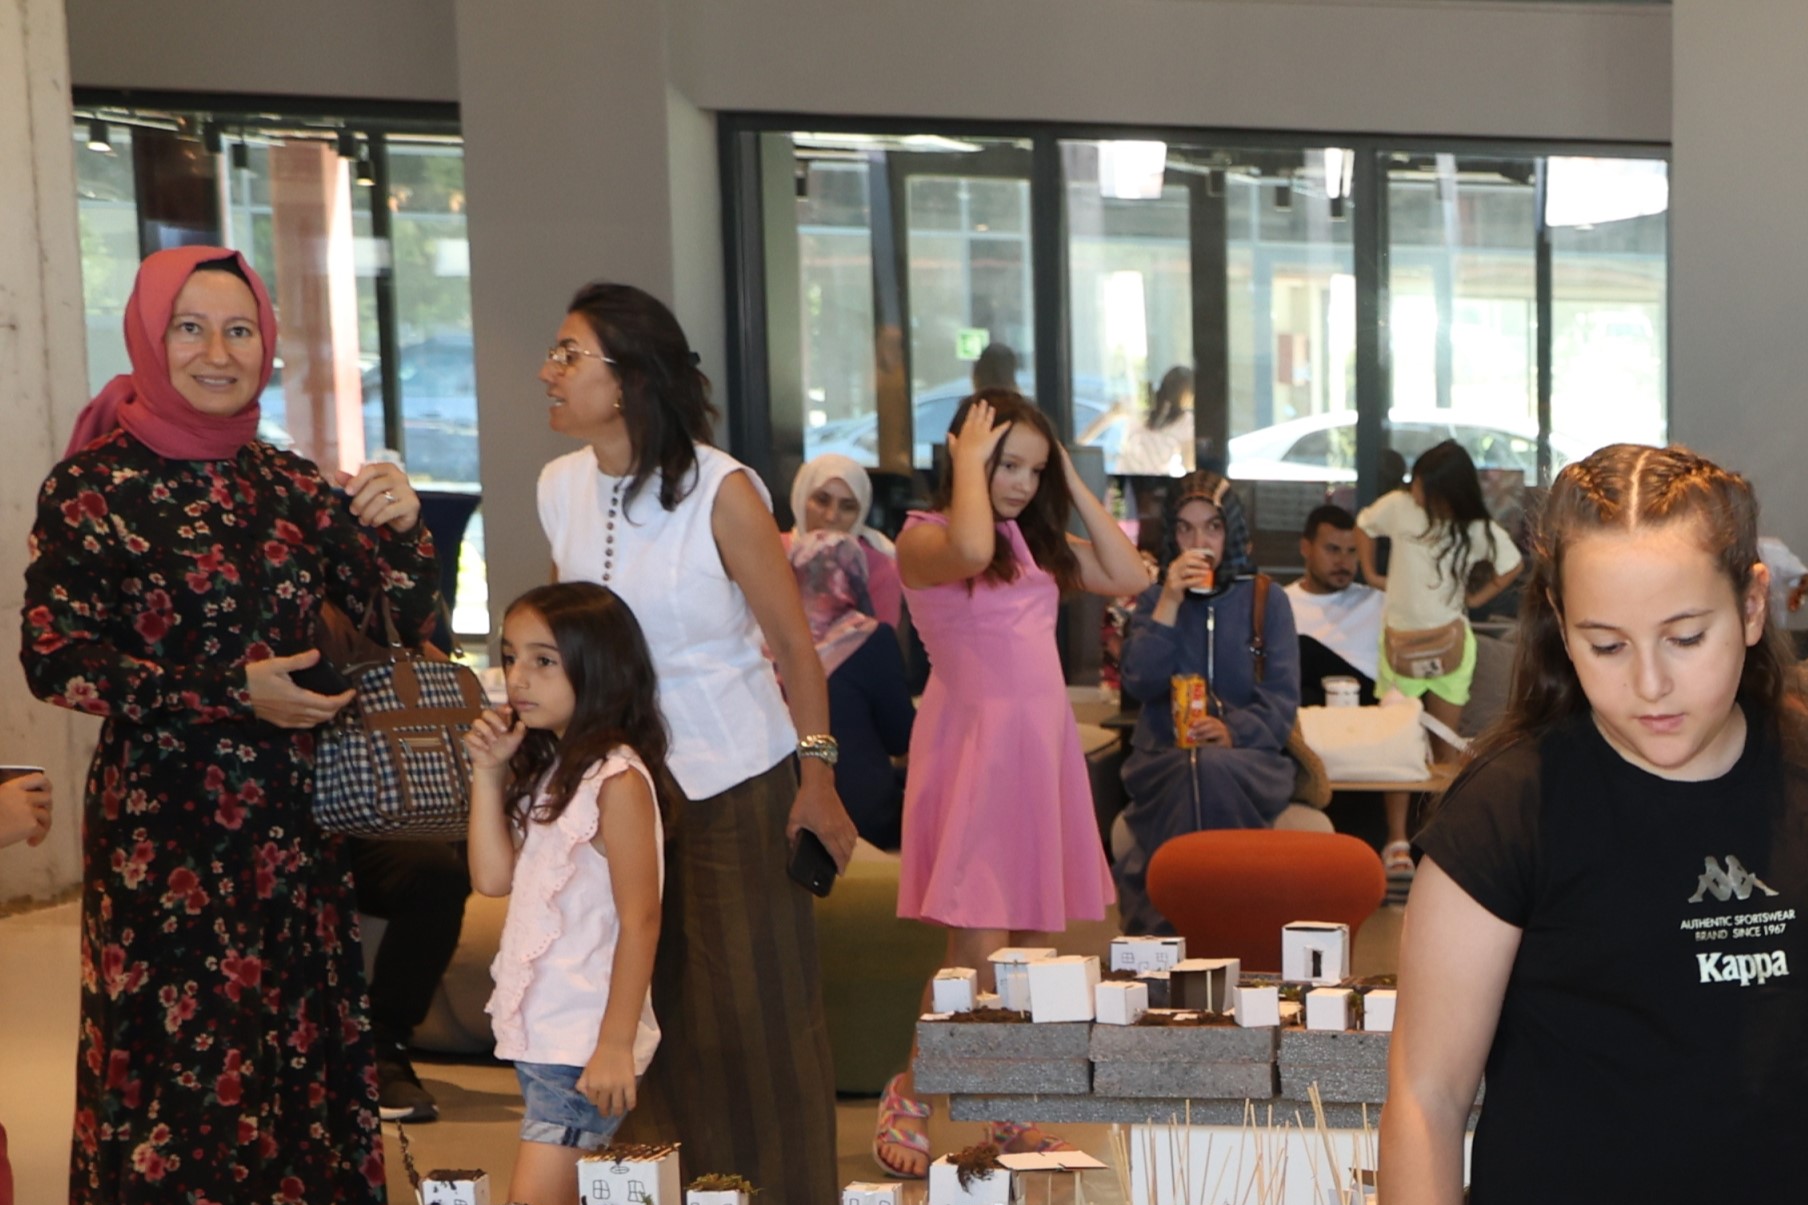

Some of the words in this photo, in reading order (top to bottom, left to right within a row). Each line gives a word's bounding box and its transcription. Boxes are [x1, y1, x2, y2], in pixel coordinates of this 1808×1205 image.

[1680, 916, 1732, 930] AUTHENTIC
[1734, 909, 1796, 926] SPORTSWEAR
[1695, 929, 1728, 941] BRAND
[1732, 926, 1761, 938] SINCE
[1763, 923, 1786, 935] 1967
[1696, 949, 1789, 987] Kappa
